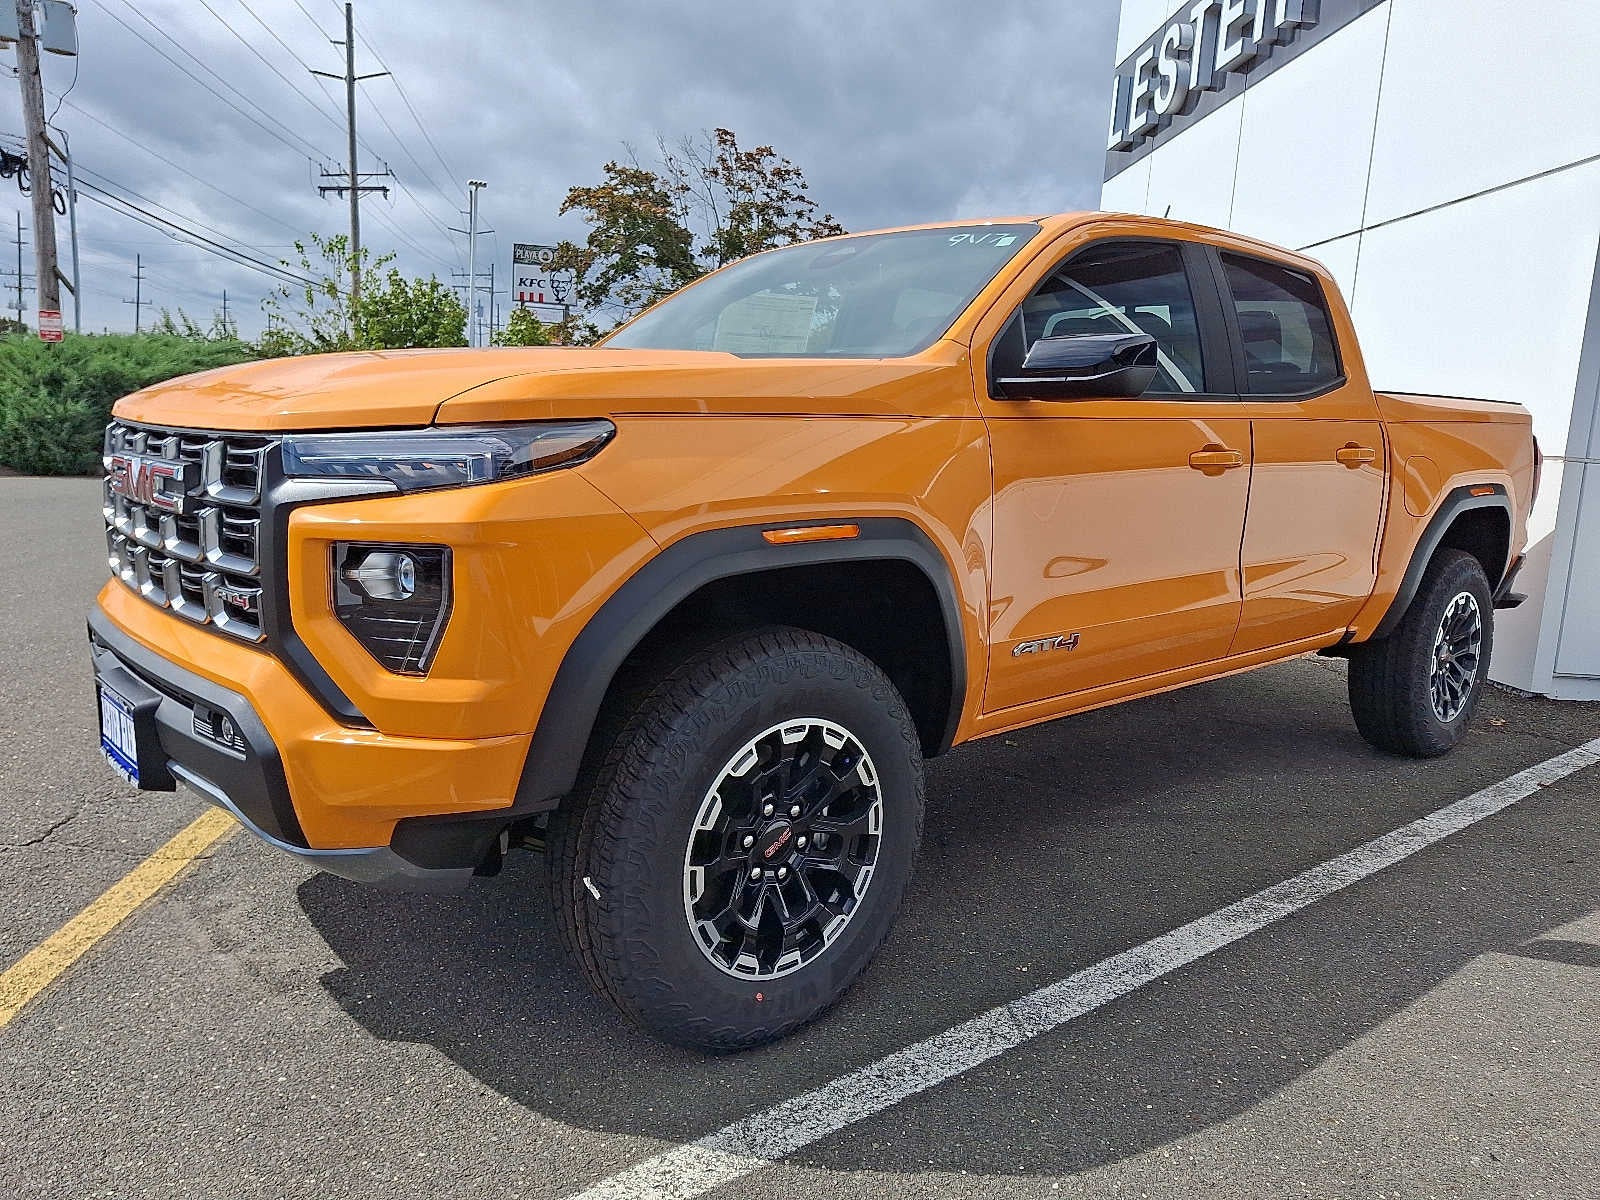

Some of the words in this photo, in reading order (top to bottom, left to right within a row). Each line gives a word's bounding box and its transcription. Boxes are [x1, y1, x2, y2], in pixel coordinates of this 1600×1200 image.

[519, 277, 546, 288] KFC
[108, 455, 184, 515] GMC
[1011, 633, 1080, 656] AT4
[764, 827, 792, 858] GMC
